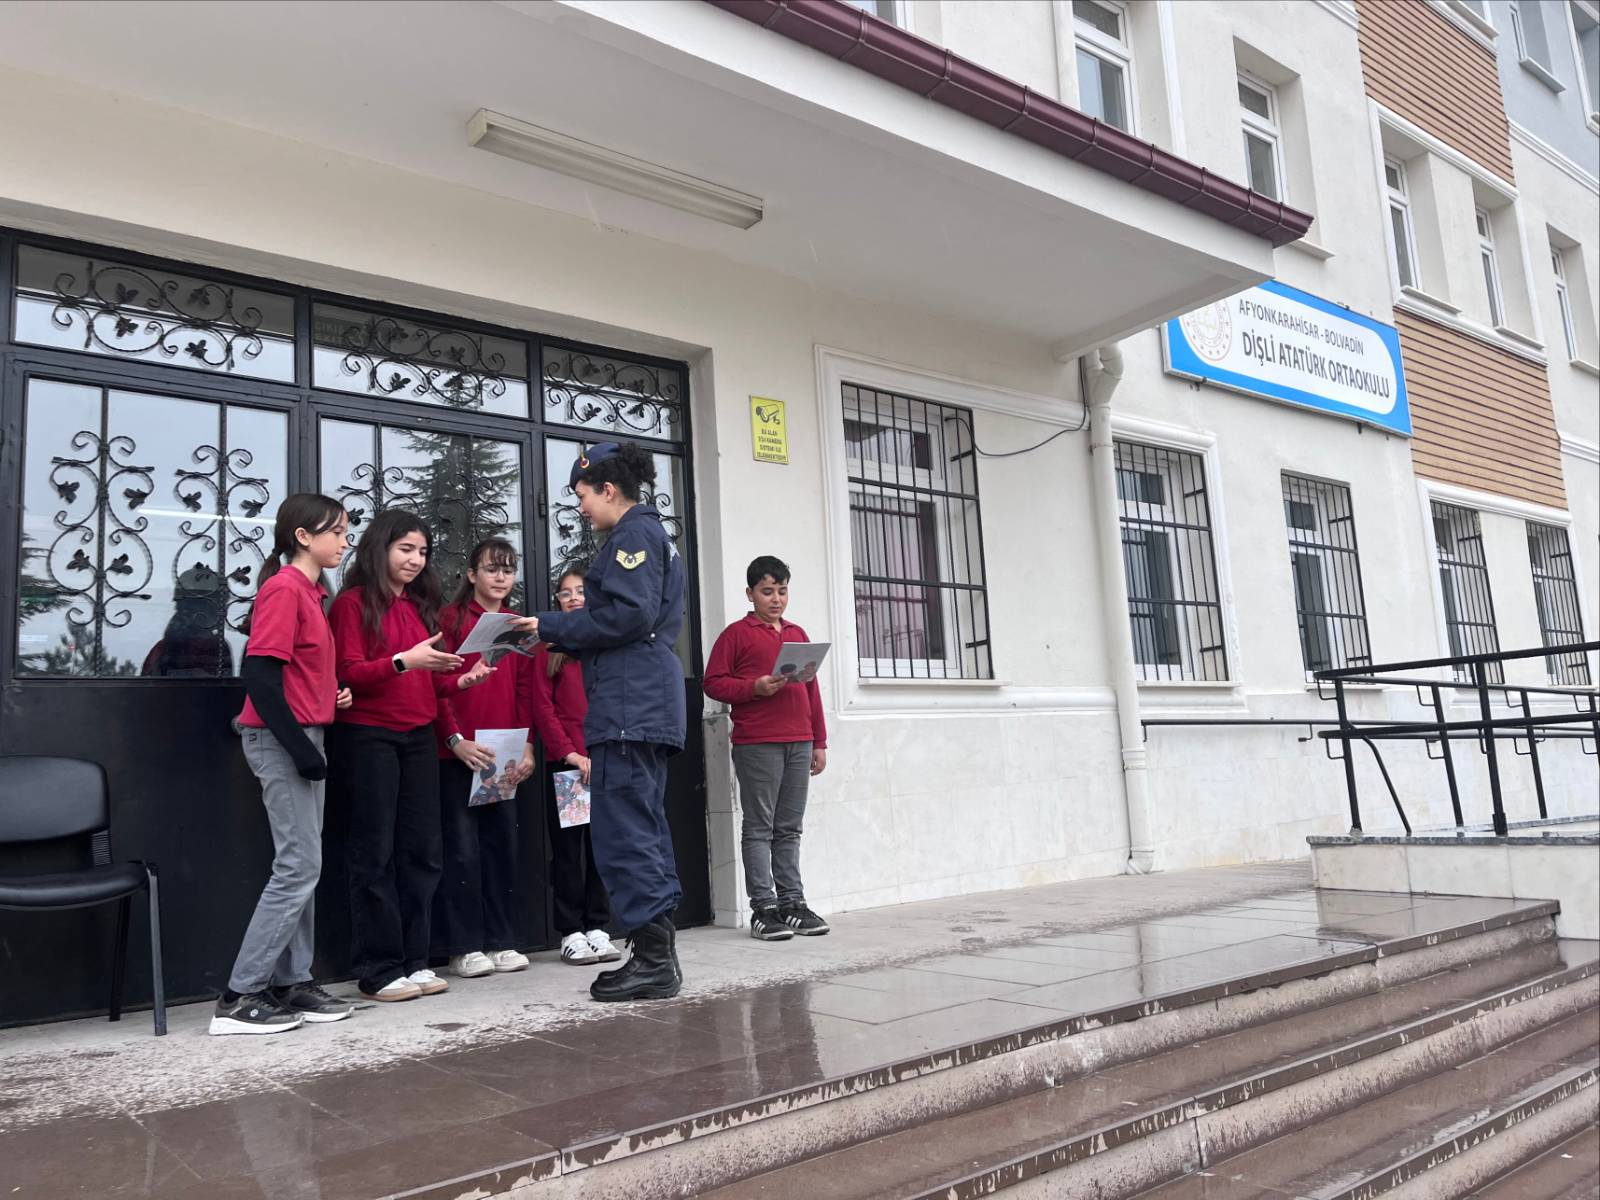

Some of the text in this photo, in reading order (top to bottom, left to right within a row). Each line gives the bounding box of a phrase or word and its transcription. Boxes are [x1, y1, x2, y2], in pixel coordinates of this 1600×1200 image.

[1239, 298, 1319, 339] AFYONKARAHİSAR
[1324, 329, 1364, 356] BOLVADİN
[1242, 329, 1276, 366] DİŞLİ
[1279, 344, 1327, 379] ATATÜRK
[1328, 360, 1390, 399] ORTAOKULU
